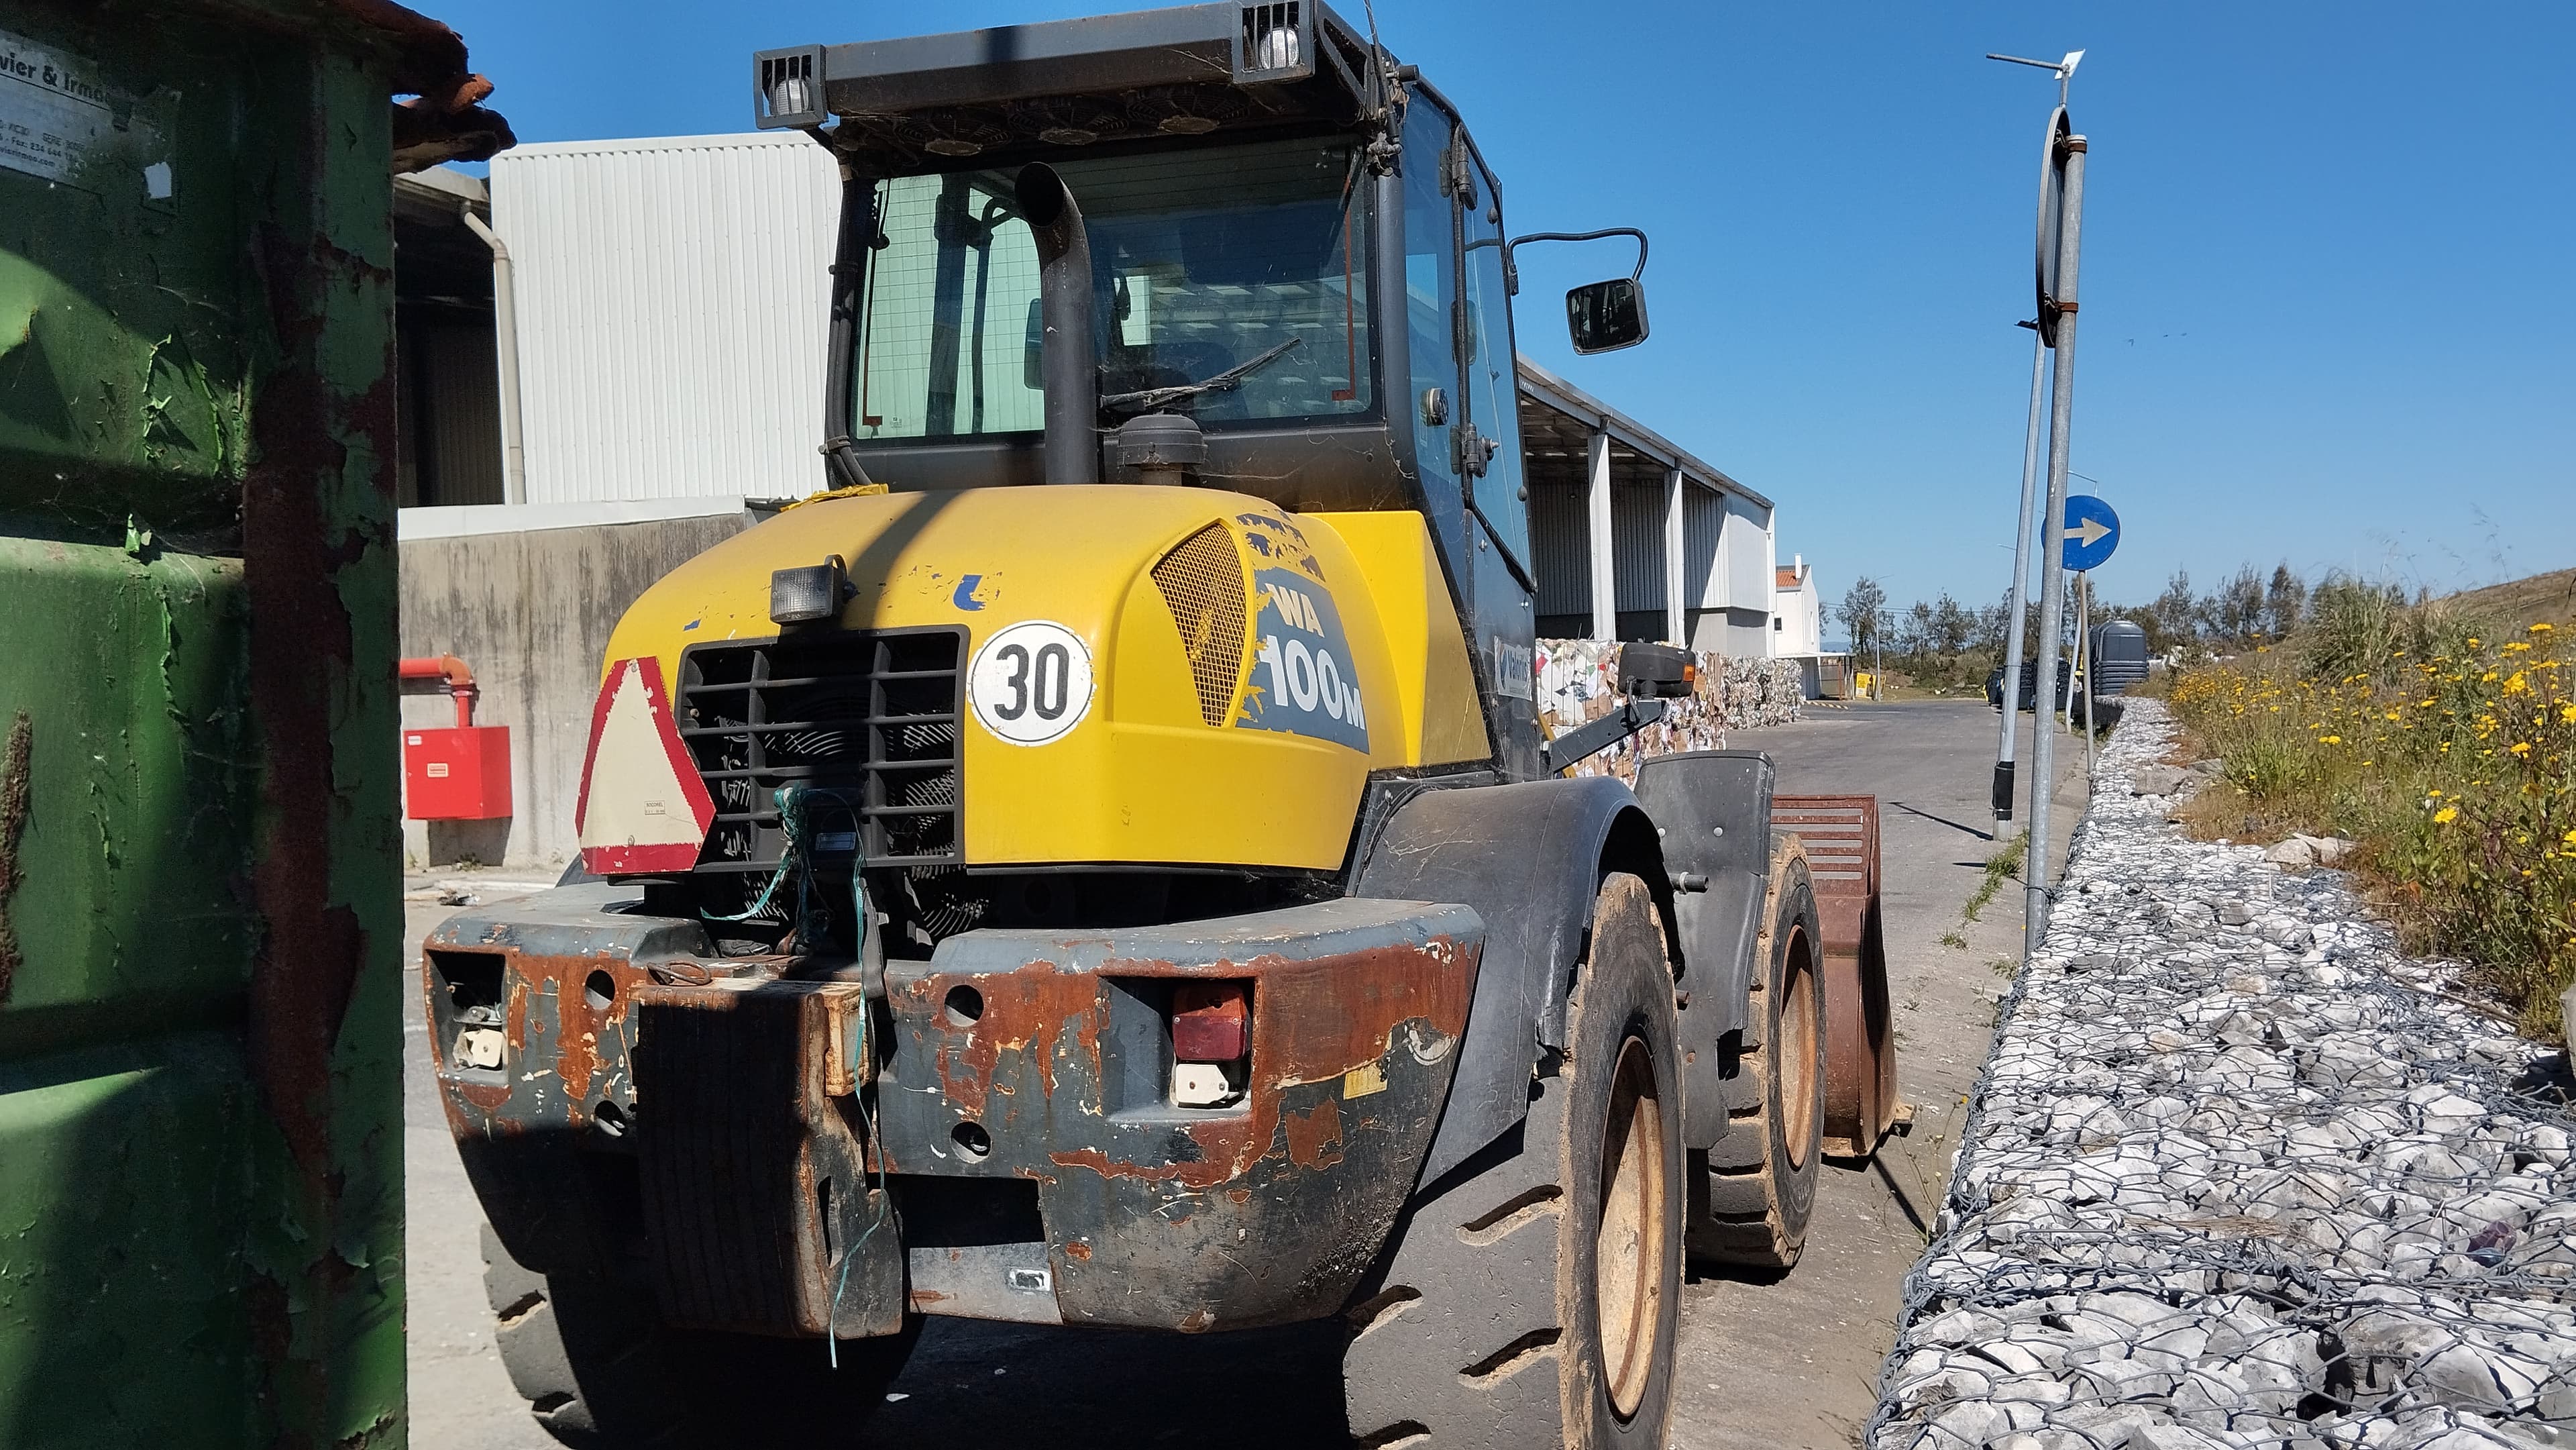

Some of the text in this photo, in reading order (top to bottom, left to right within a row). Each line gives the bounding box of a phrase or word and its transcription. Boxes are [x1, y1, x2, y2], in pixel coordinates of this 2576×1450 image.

[42, 65, 58, 87] &
[1265, 582, 1325, 638] WA
[994, 643, 1069, 721] 30
